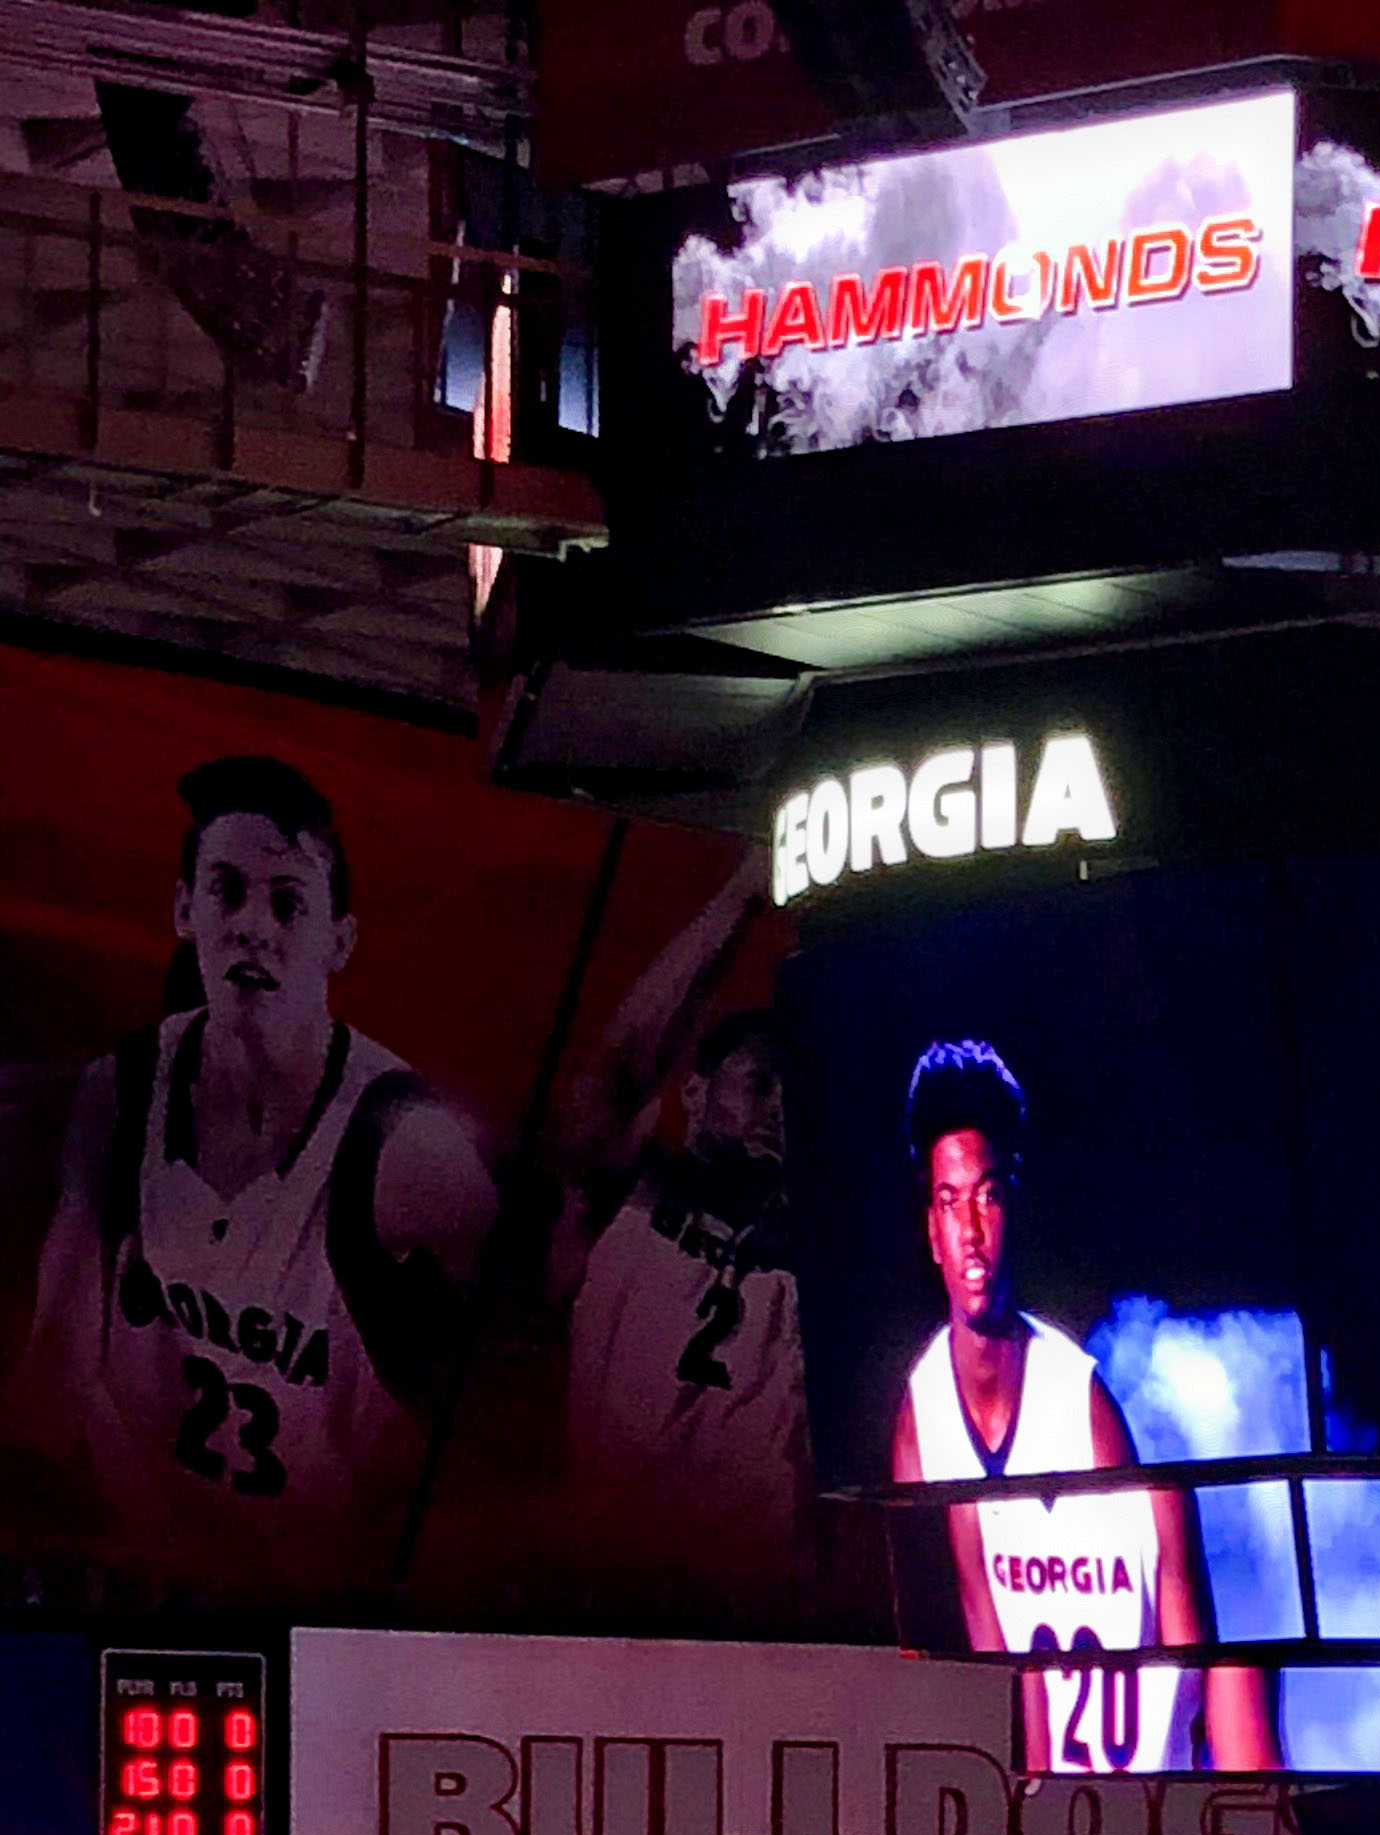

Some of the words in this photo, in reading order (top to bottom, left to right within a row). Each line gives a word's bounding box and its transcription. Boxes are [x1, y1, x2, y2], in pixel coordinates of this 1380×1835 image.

[699, 217, 1262, 367] HAMMONDS
[178, 1356, 286, 1495] 23
[991, 1555, 1134, 1595] GEORGIA
[1040, 1630, 1138, 1770] 20
